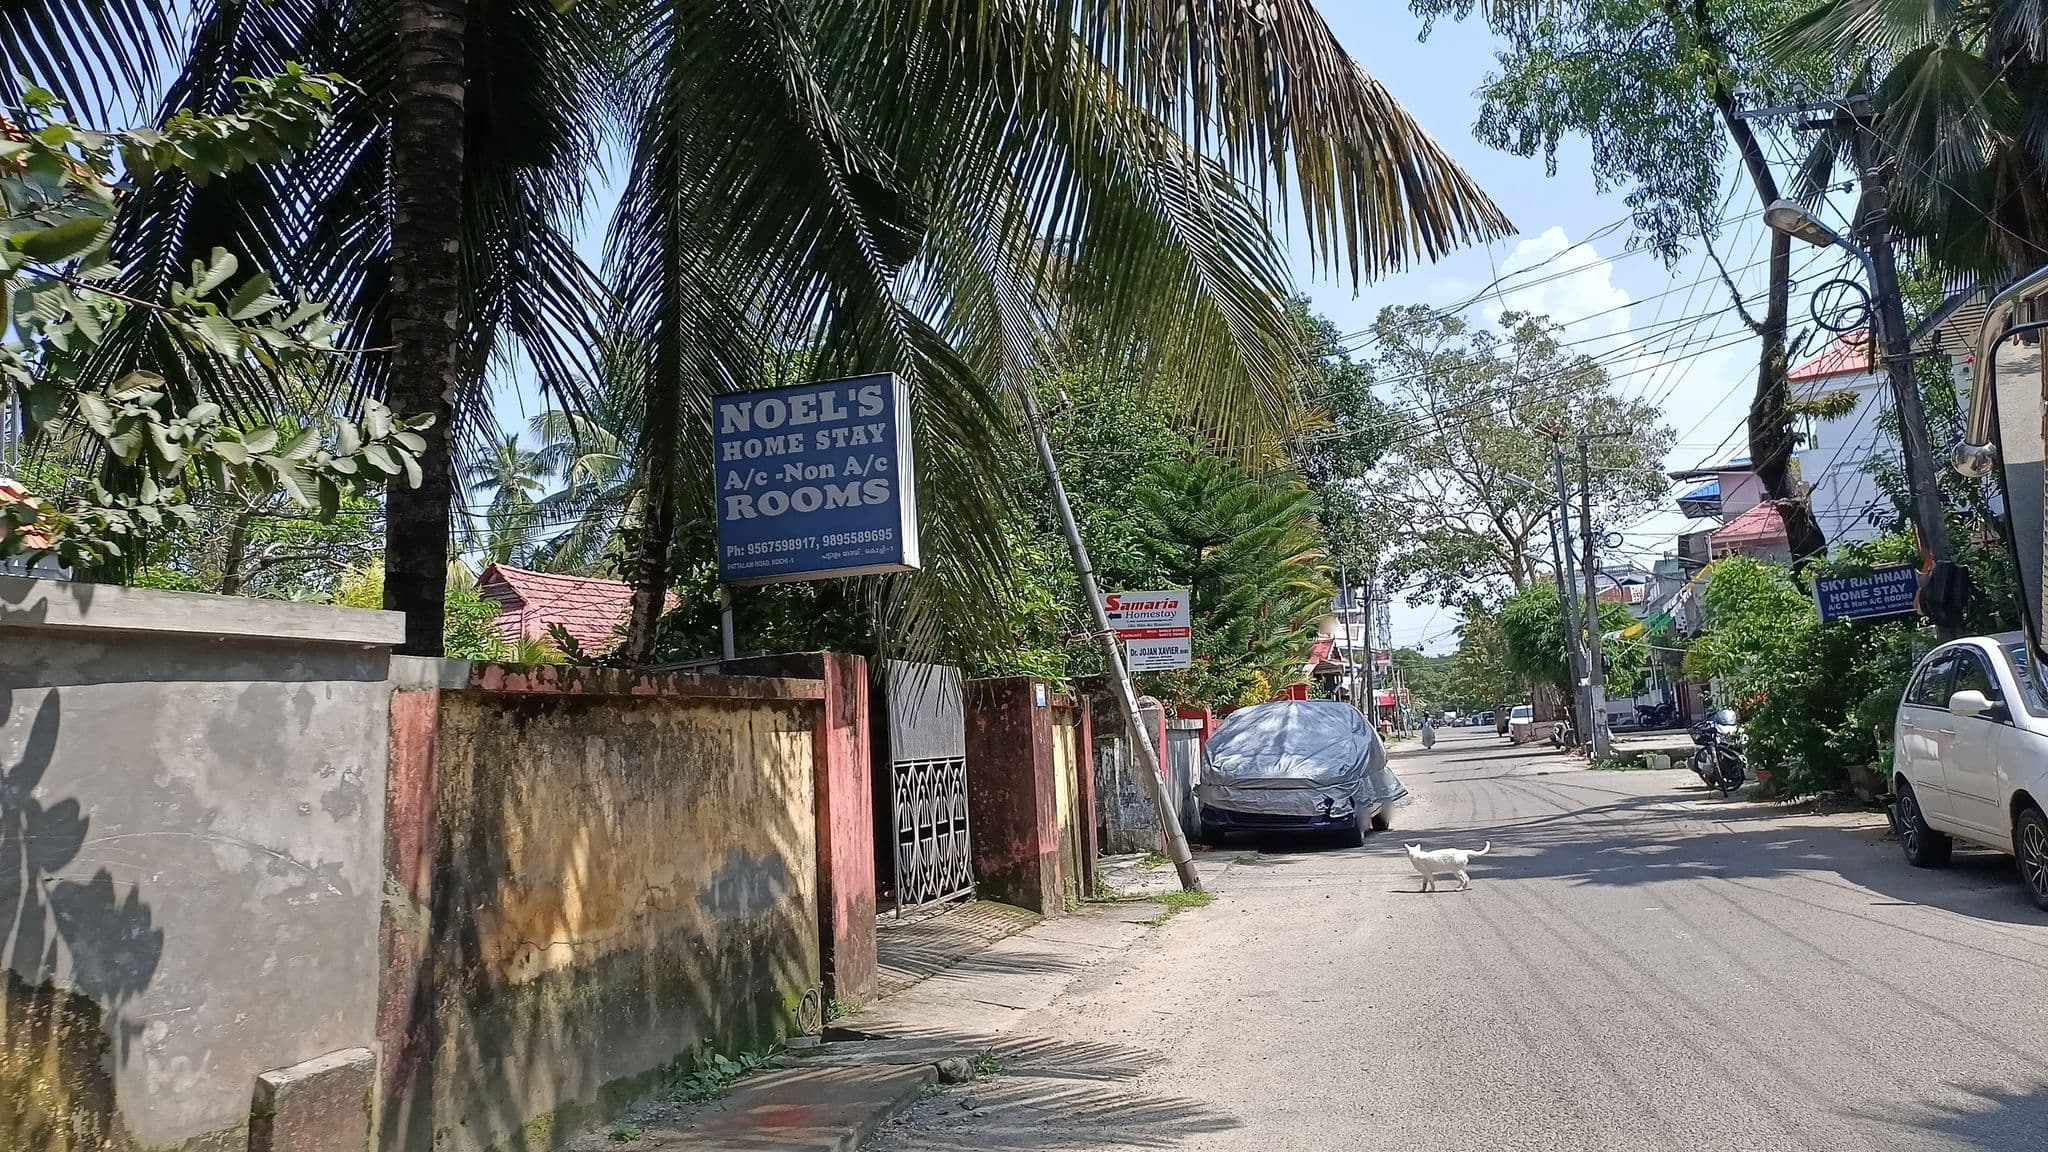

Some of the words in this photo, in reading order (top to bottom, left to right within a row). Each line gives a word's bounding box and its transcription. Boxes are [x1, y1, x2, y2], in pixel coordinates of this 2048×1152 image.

[720, 385, 884, 434] NOEL'S
[722, 433, 804, 461] HOME
[815, 422, 886, 450] STAY
[724, 468, 768, 491] A/c
[843, 453, 888, 477] A/c
[725, 478, 890, 521] ROOMS
[726, 545, 745, 558] Ph:
[747, 536, 820, 555] 9567598917,
[822, 527, 893, 547] 9895589695
[1820, 579, 1847, 592] SKY
[1830, 589, 1869, 603] HOME
[1873, 583, 1906, 597] STAY
[1104, 595, 1179, 612] Samaria
[1828, 603, 1842, 611] A/C
[1869, 597, 1883, 606] A/C
[1884, 592, 1913, 603] ROOMS
[1125, 611, 1177, 619] Homestay
[1130, 649, 1138, 657] Dr.
[1140, 647, 1158, 656] JOJAN
[1158, 646, 1179, 655] XAVIER
